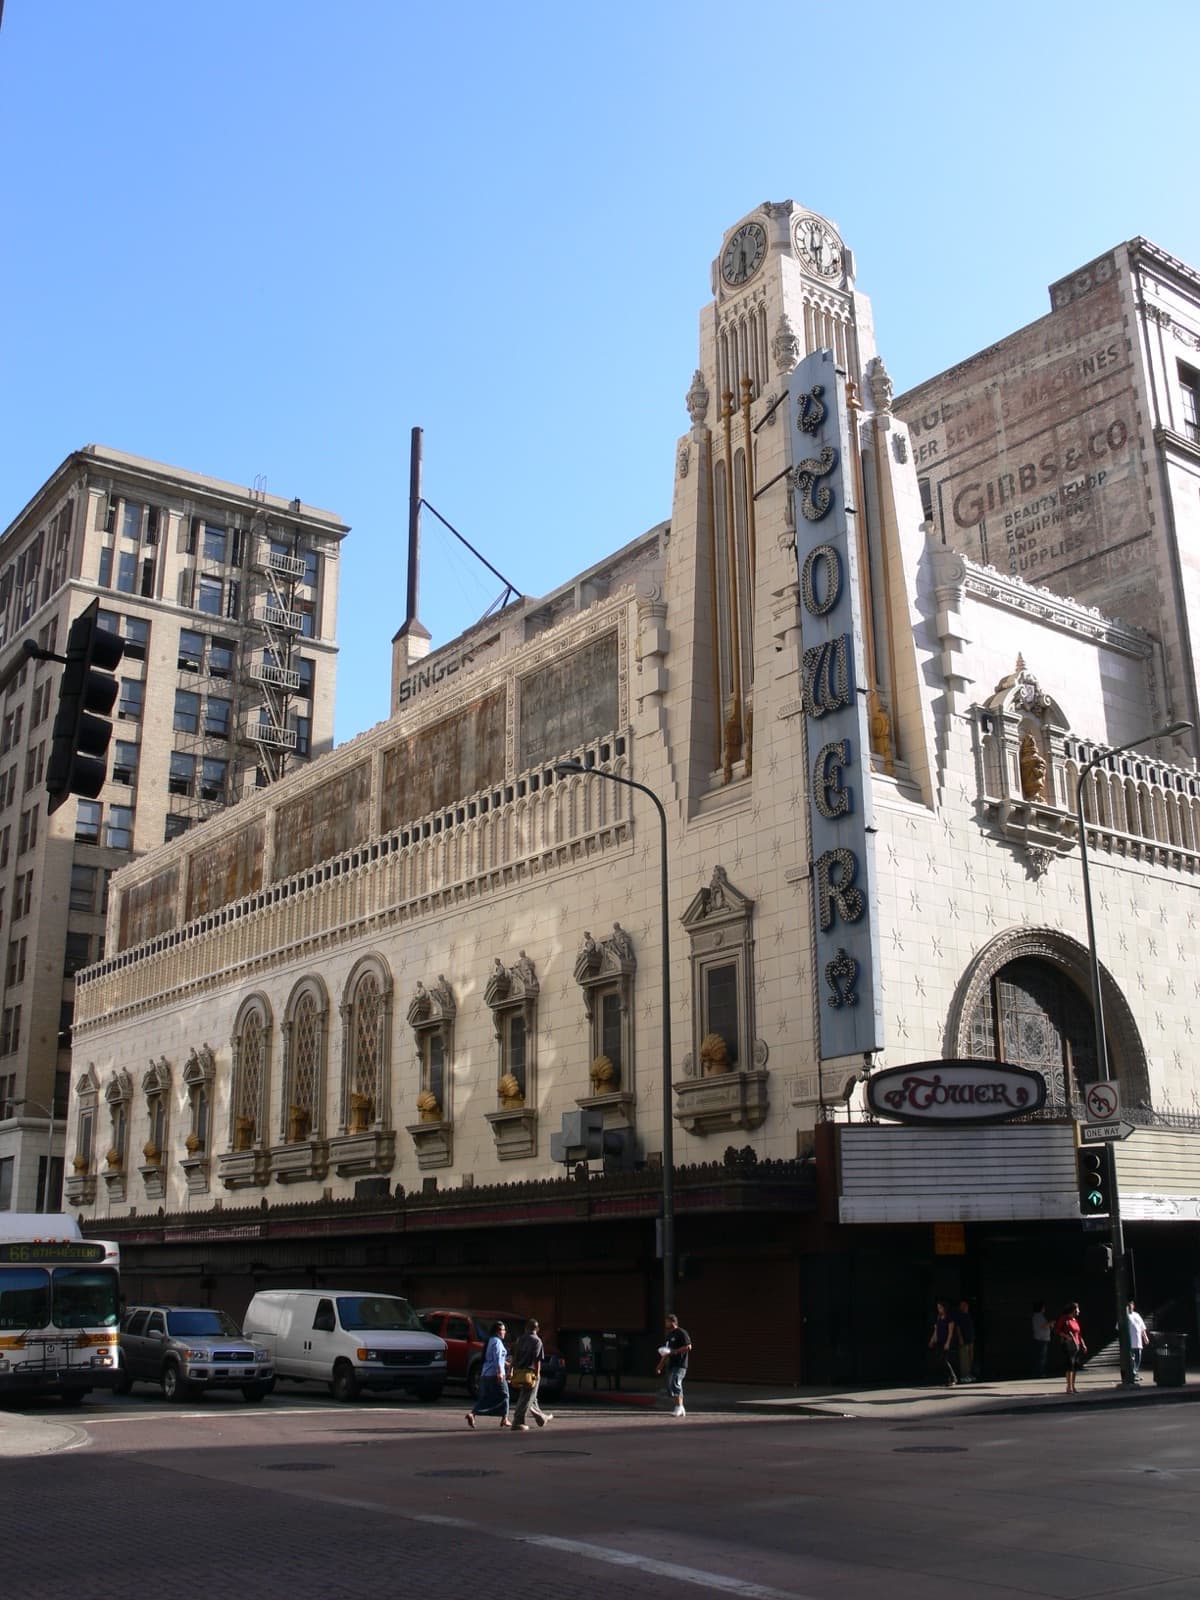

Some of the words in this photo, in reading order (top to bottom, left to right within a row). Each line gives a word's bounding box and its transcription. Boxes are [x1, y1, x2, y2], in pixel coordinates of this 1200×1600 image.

[953, 452, 1058, 529] GIBBS
[1065, 443, 1087, 472] &
[1088, 419, 1128, 459] CO
[1004, 492, 1058, 528] BEAUTY
[1008, 538, 1037, 560] AND
[1086, 1128, 1103, 1138] ONE
[1104, 1126, 1121, 1136] WAY
[9, 1247, 30, 1260] 66
